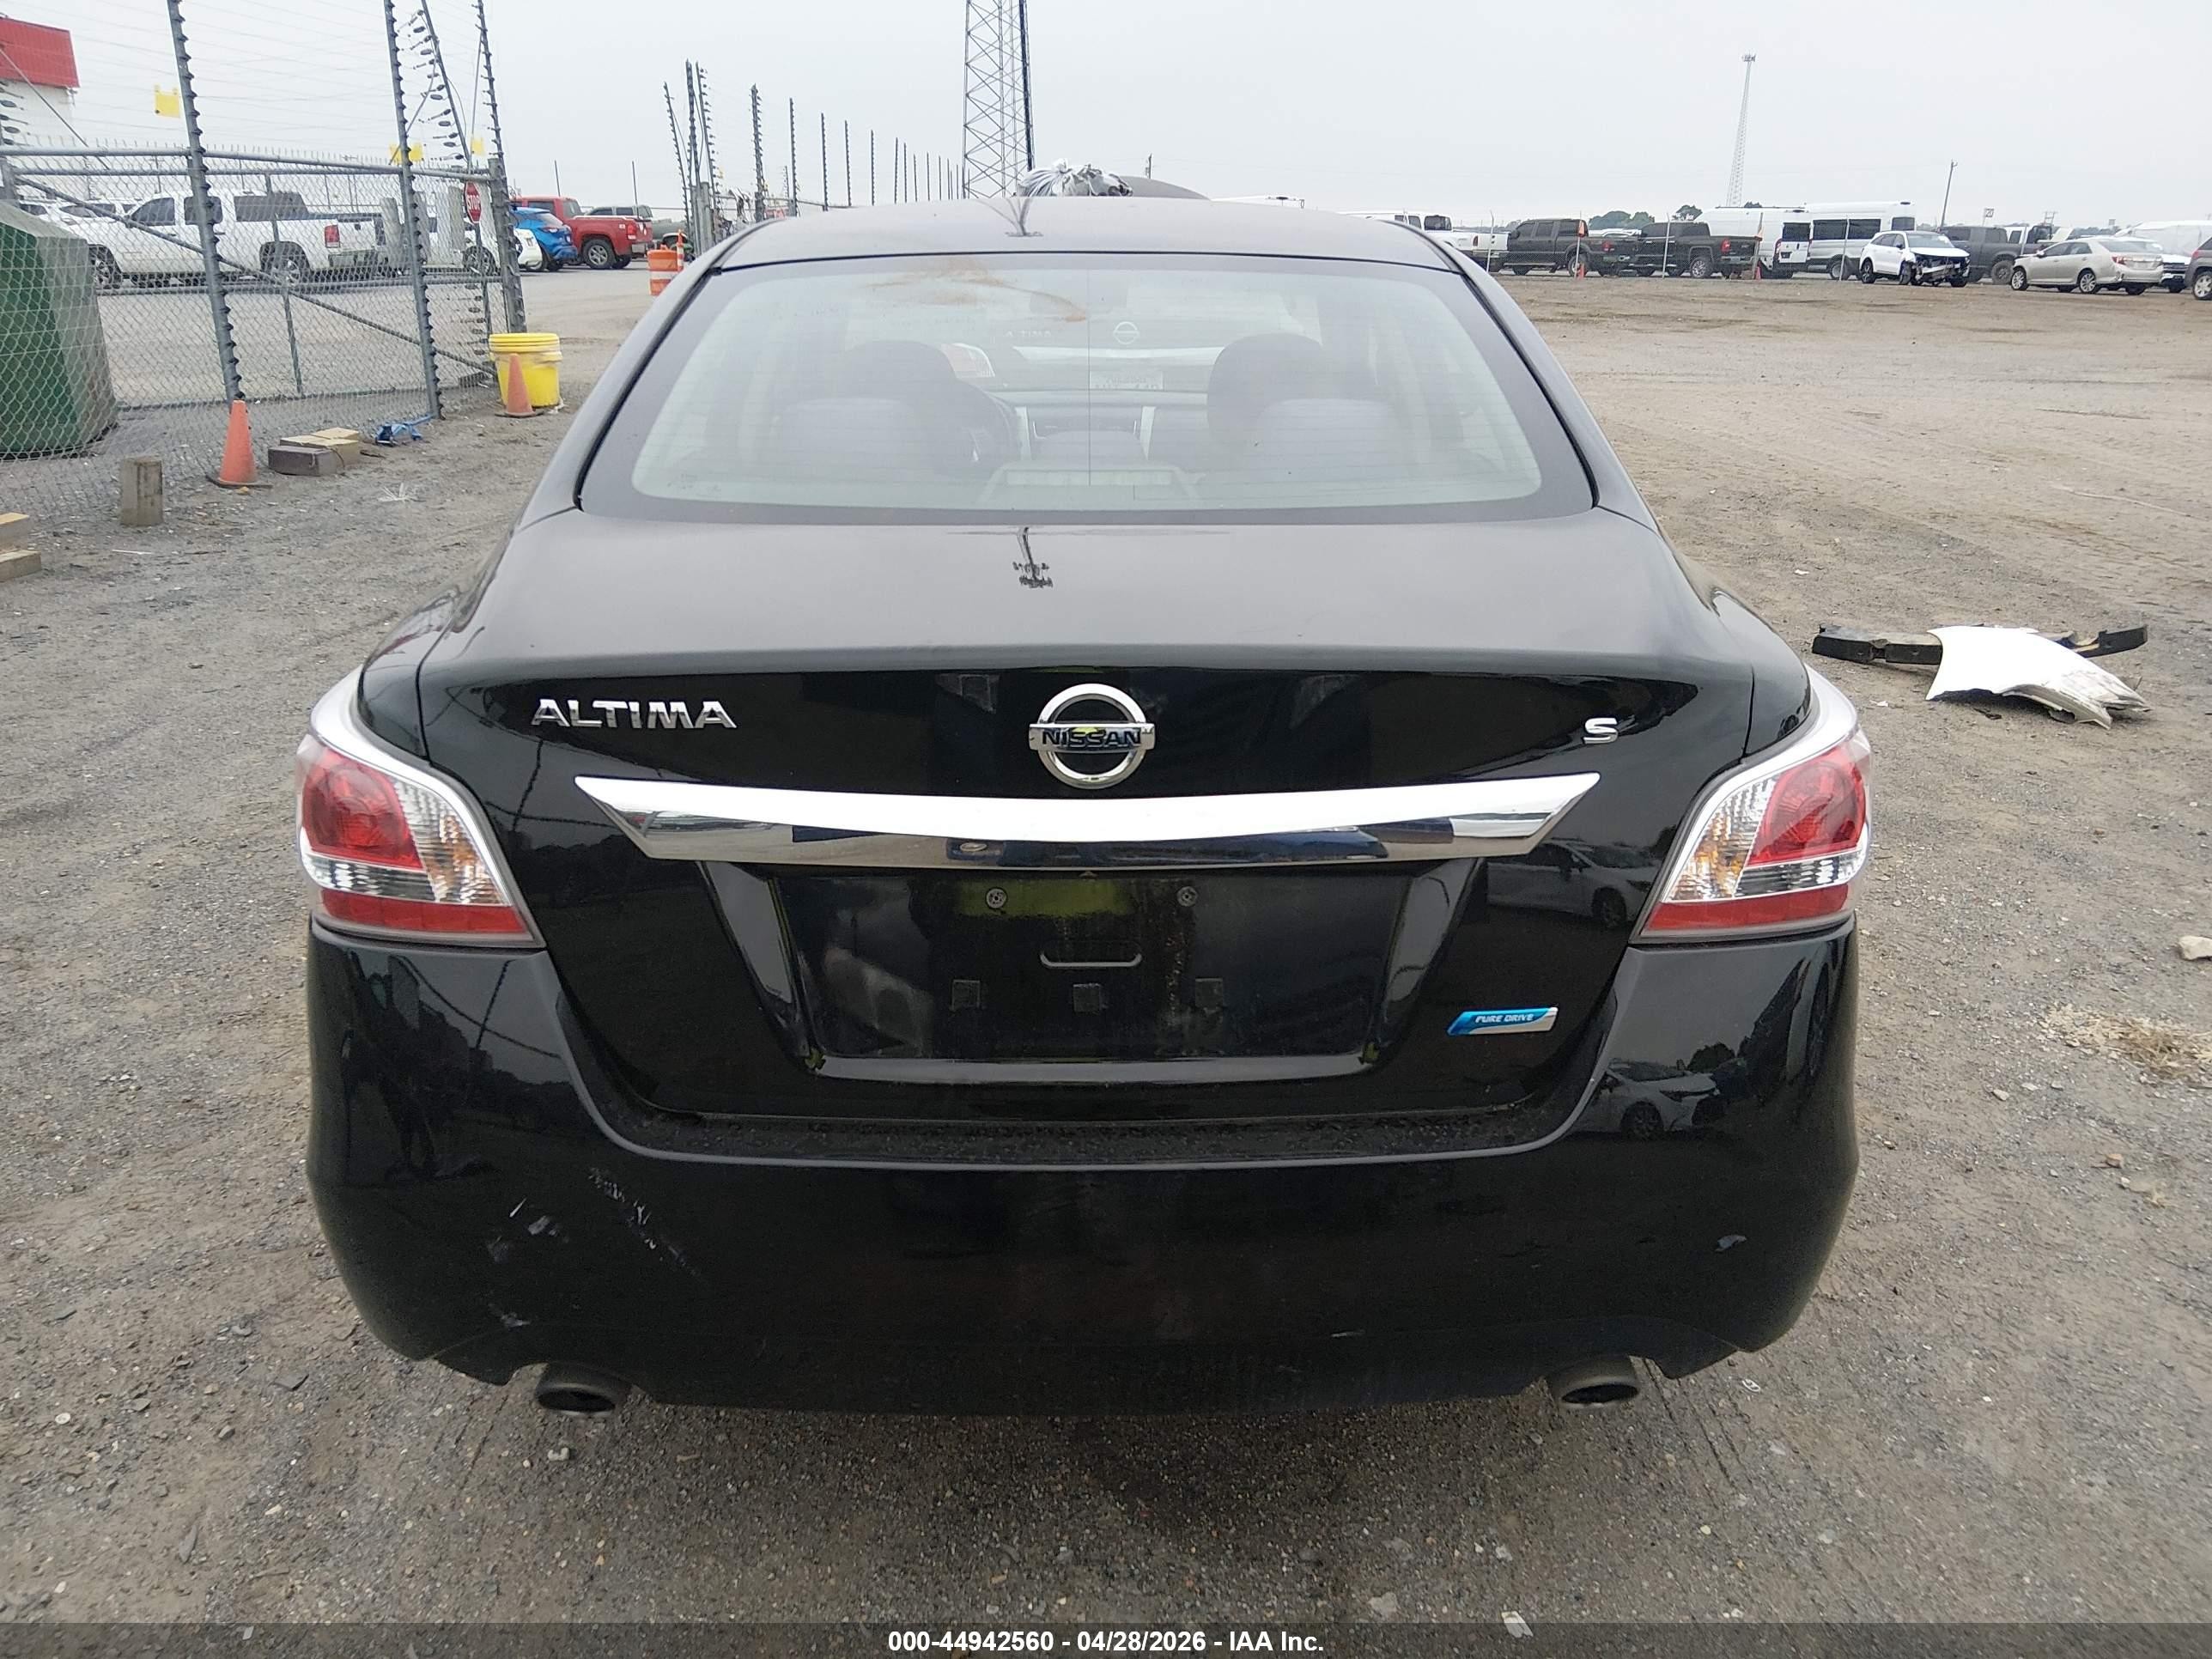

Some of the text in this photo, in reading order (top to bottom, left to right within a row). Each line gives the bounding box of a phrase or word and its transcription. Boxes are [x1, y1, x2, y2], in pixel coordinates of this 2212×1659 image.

[466, 194, 481, 210] STOP
[530, 698, 738, 730] ALTIMA
[1042, 729, 1141, 749] NISSAN
[1583, 717, 1619, 744] S
[1475, 1013, 1534, 1024] PURE DRIVE
